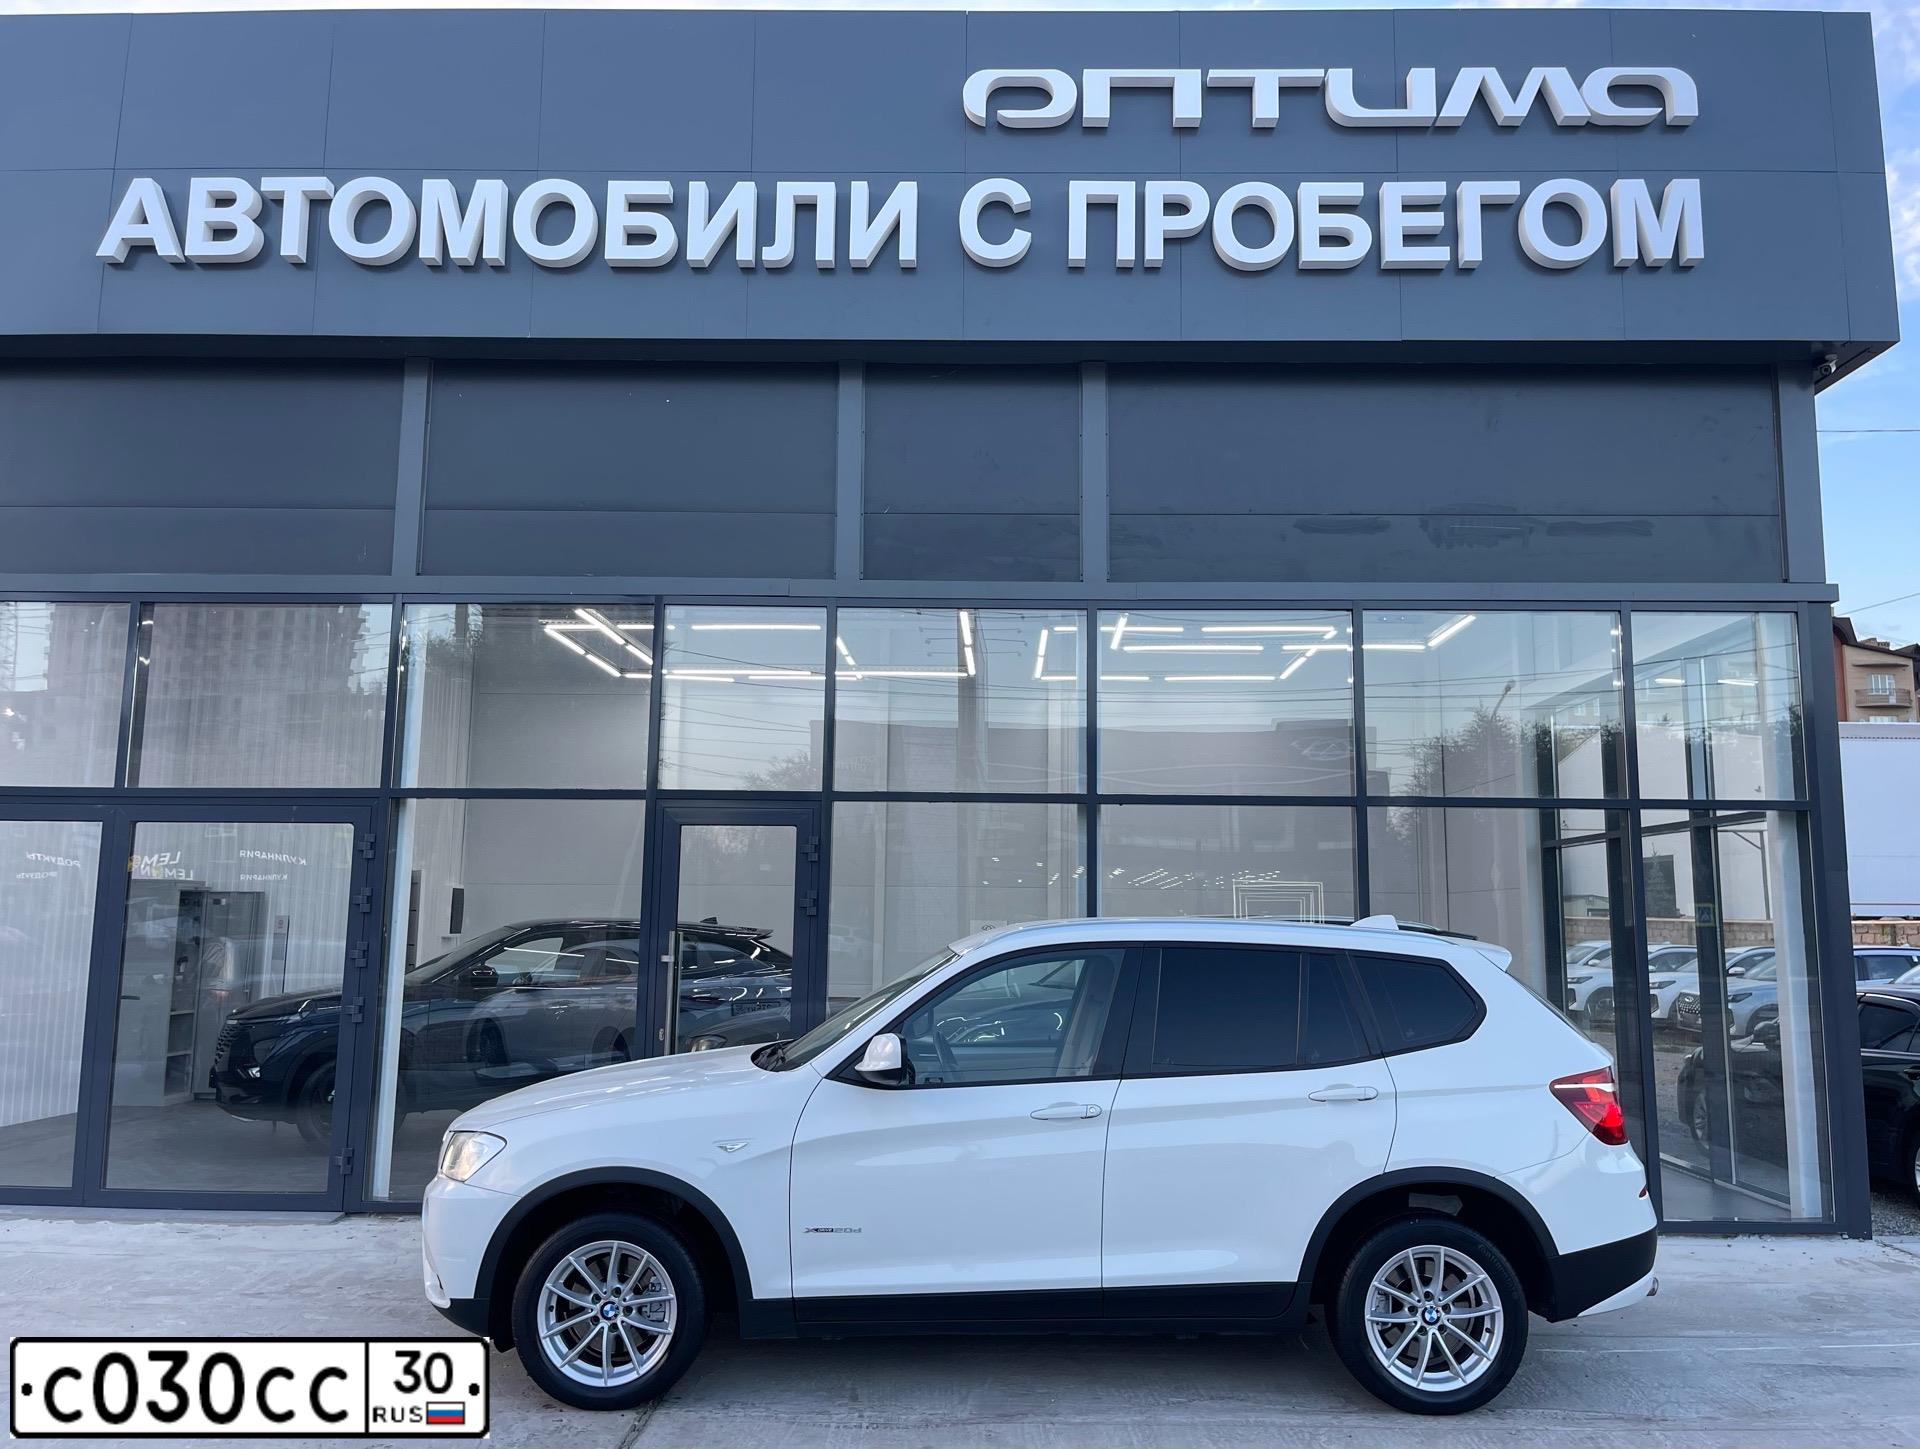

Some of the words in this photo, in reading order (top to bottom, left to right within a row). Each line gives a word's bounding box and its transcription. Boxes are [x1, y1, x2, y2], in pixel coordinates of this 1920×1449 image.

[95, 176, 919, 268] АВТОМОБИЛИ
[959, 178, 1032, 269] С
[1067, 177, 1706, 271] ПРОБЕГОМ
